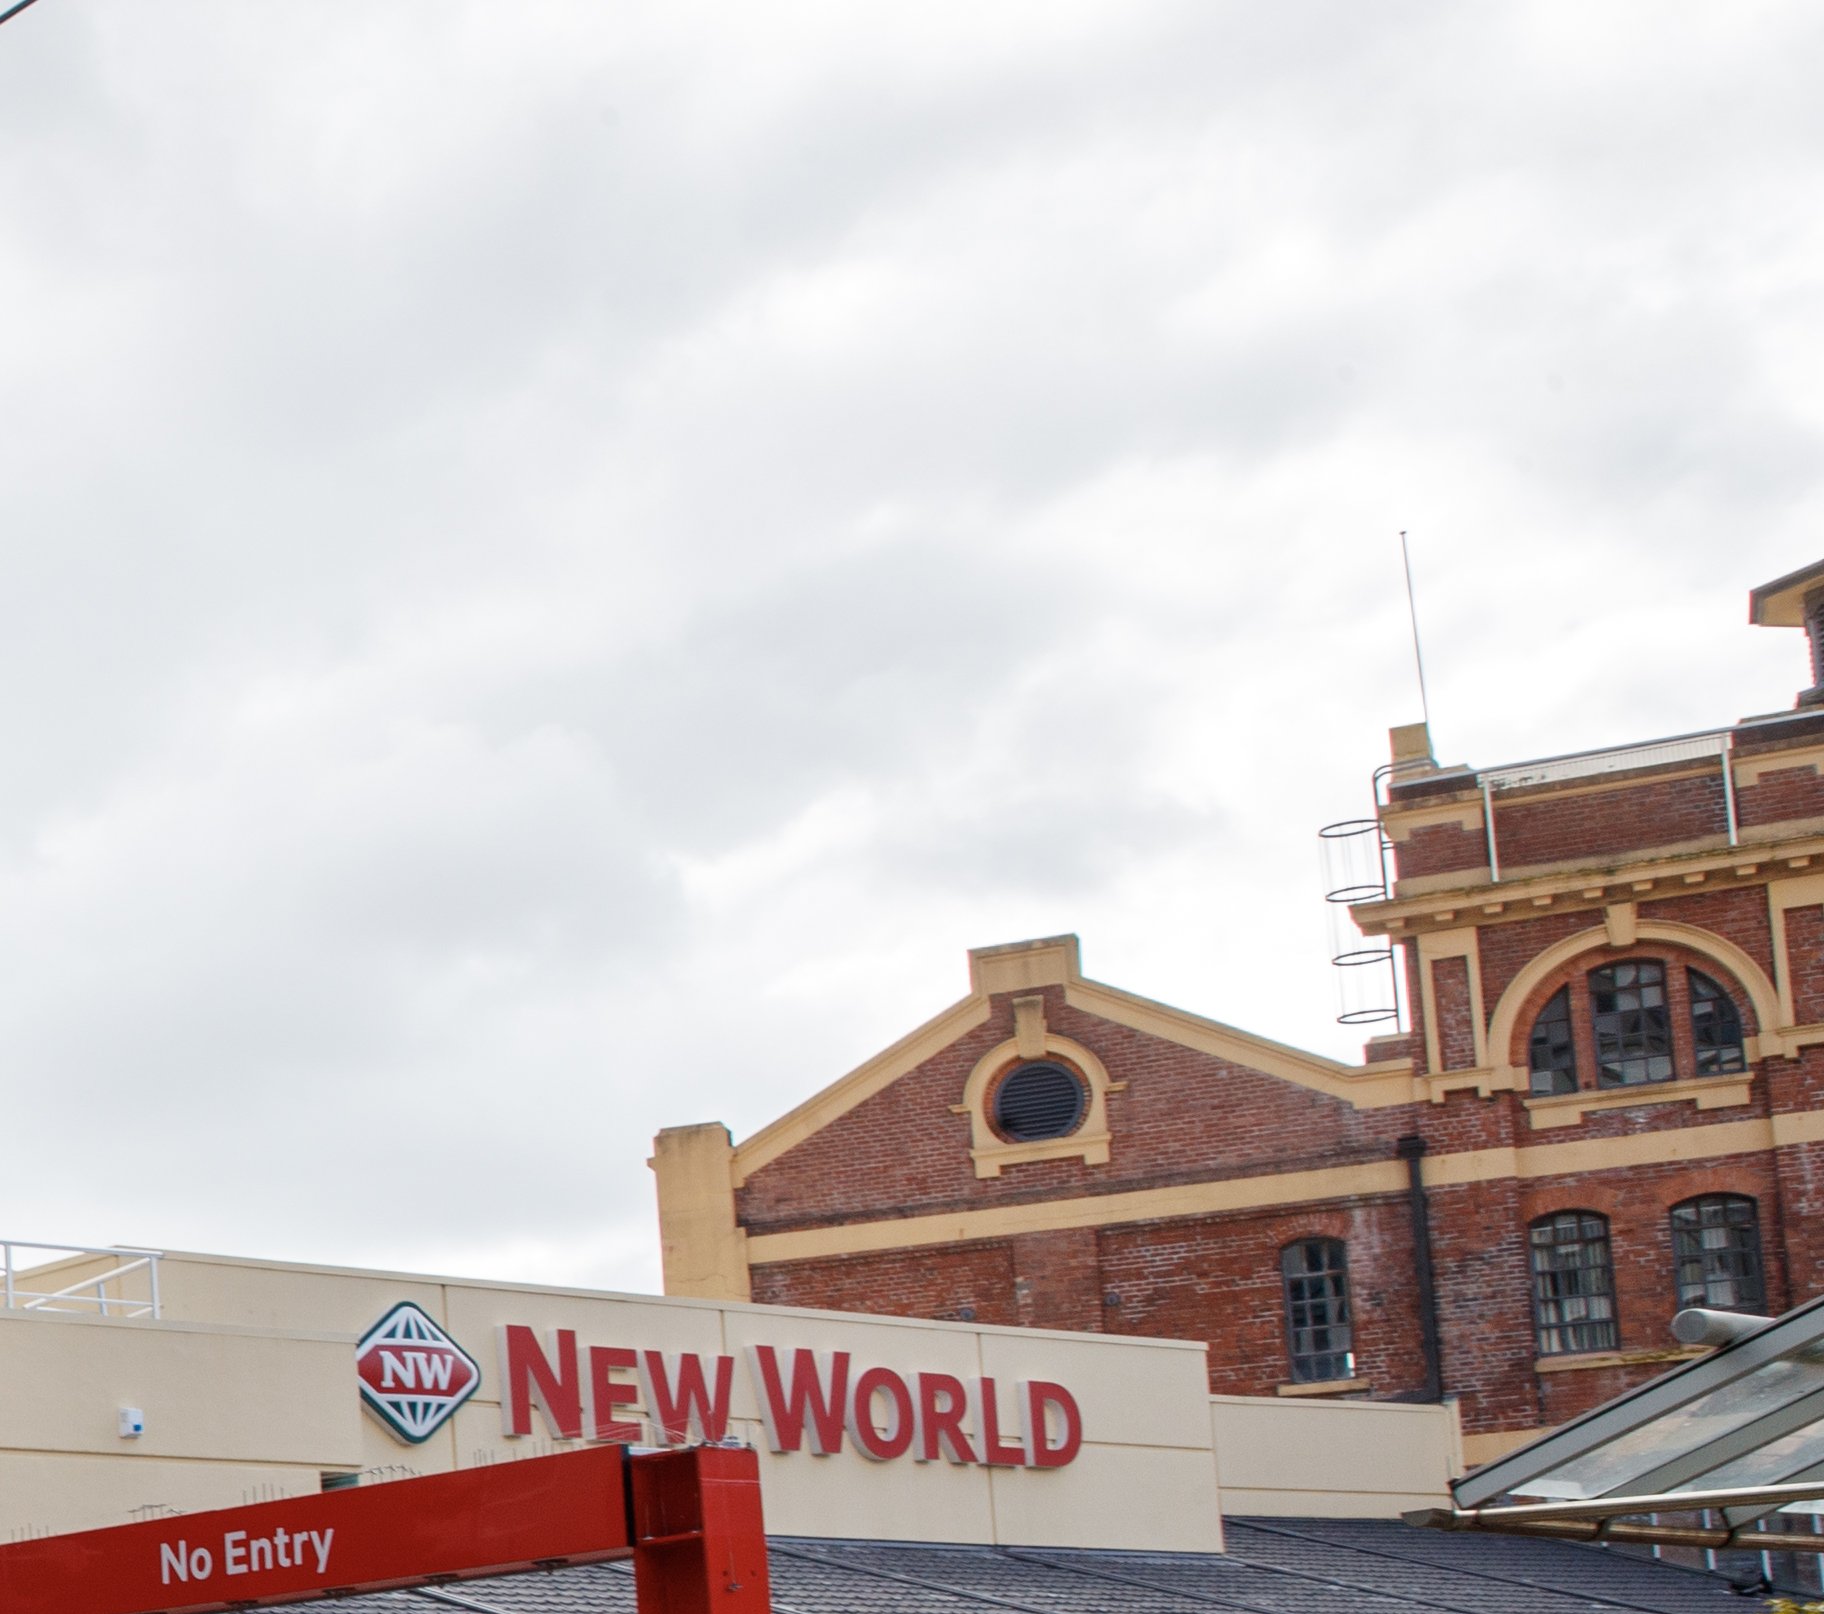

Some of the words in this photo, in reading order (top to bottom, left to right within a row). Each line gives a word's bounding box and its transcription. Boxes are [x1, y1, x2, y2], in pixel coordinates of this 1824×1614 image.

[378, 1350, 454, 1391] NW
[498, 1323, 735, 1444] NEW
[755, 1344, 1083, 1469] WORLD
[160, 1537, 213, 1586] No
[224, 1525, 336, 1578] Entry
